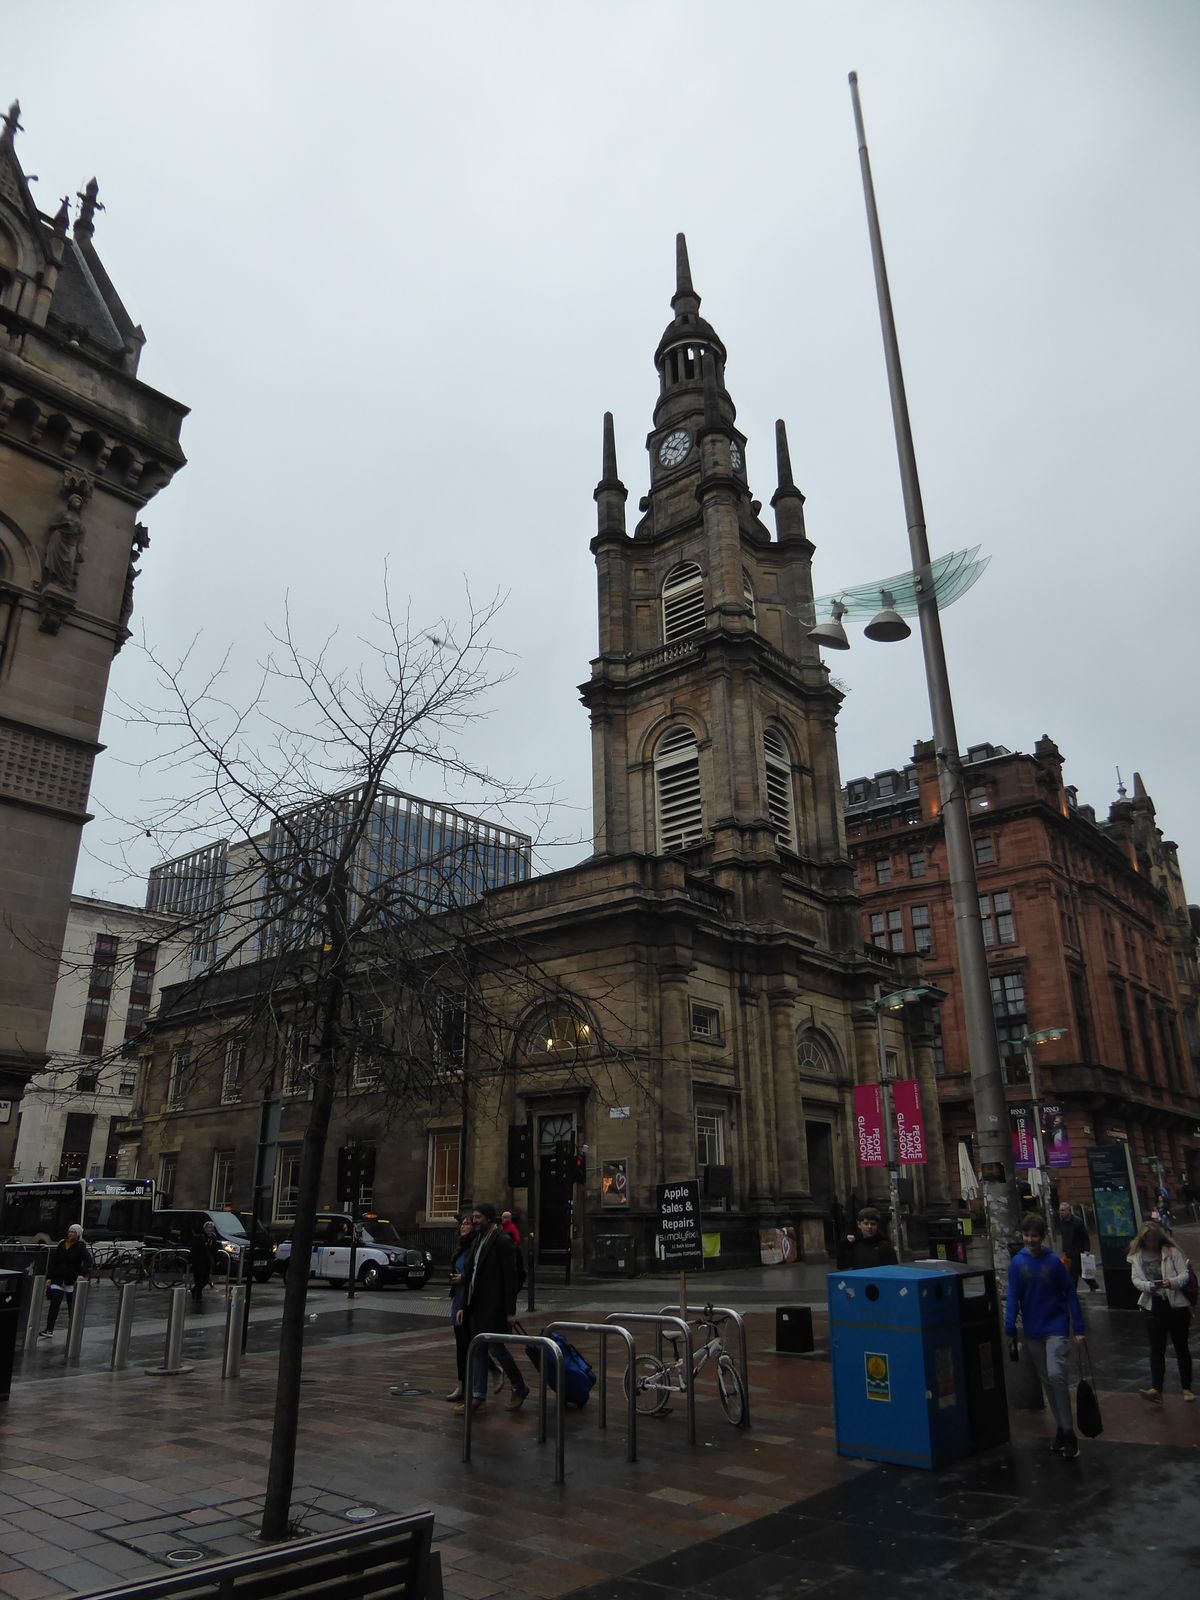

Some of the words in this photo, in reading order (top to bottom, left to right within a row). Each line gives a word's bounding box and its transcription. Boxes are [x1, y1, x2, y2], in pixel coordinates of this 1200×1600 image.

[1019, 1118, 1026, 1129] ON
[857, 1115, 868, 1162] GLASGOW
[872, 1127, 882, 1161] PEOPLE
[897, 1112, 908, 1160] GLASGOW
[906, 1132, 915, 1159] MAKE
[912, 1124, 923, 1159] PEOPLE
[1020, 1128, 1028, 1144] SALE
[866, 1135, 875, 1162] MAKE
[135, 1186, 145, 1195] 901
[664, 1187, 689, 1200] Apple
[661, 1202, 684, 1214] Sales
[685, 1200, 694, 1212] &
[662, 1217, 695, 1231] Repairs
